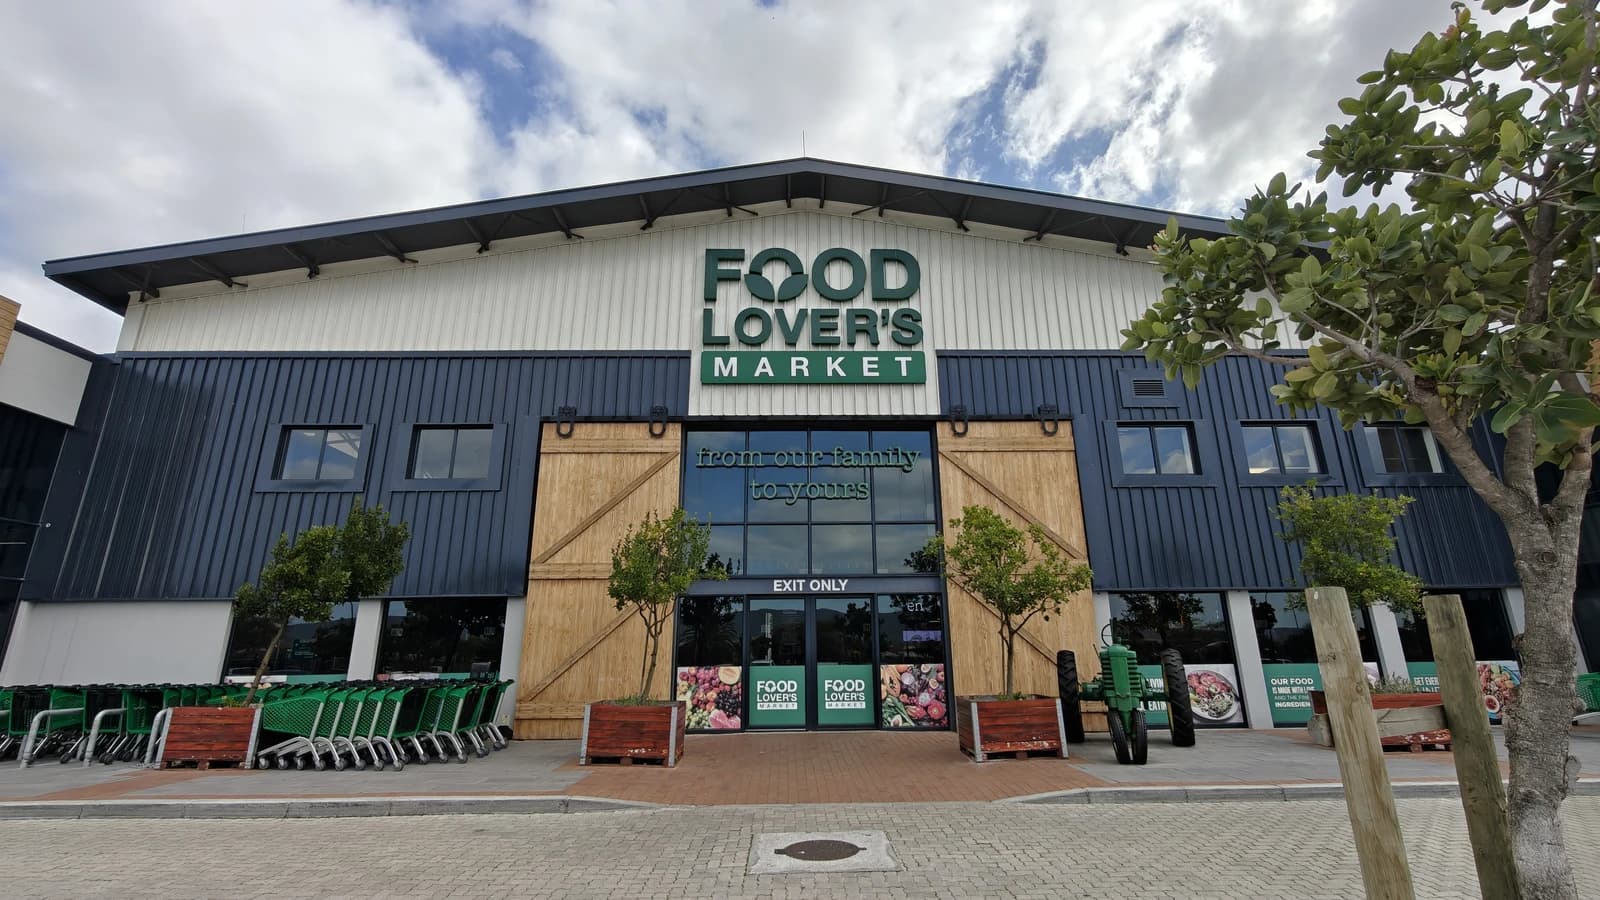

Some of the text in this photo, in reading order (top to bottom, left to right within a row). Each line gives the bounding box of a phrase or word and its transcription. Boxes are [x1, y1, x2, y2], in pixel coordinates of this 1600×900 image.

[704, 247, 921, 302] FOOD
[702, 307, 924, 346] LOVER'S
[713, 356, 913, 377] MARKET
[696, 447, 921, 473] from our family
[751, 479, 870, 506] to yours
[773, 579, 849, 592] EXIT ONLY
[757, 680, 798, 693] FOOD
[825, 679, 866, 692] FOOD
[1425, 677, 1439, 685] EVER
[757, 693, 798, 702] LOVER'S
[825, 692, 866, 701] LOVER'S
[1148, 701, 1168, 711] EATIN
